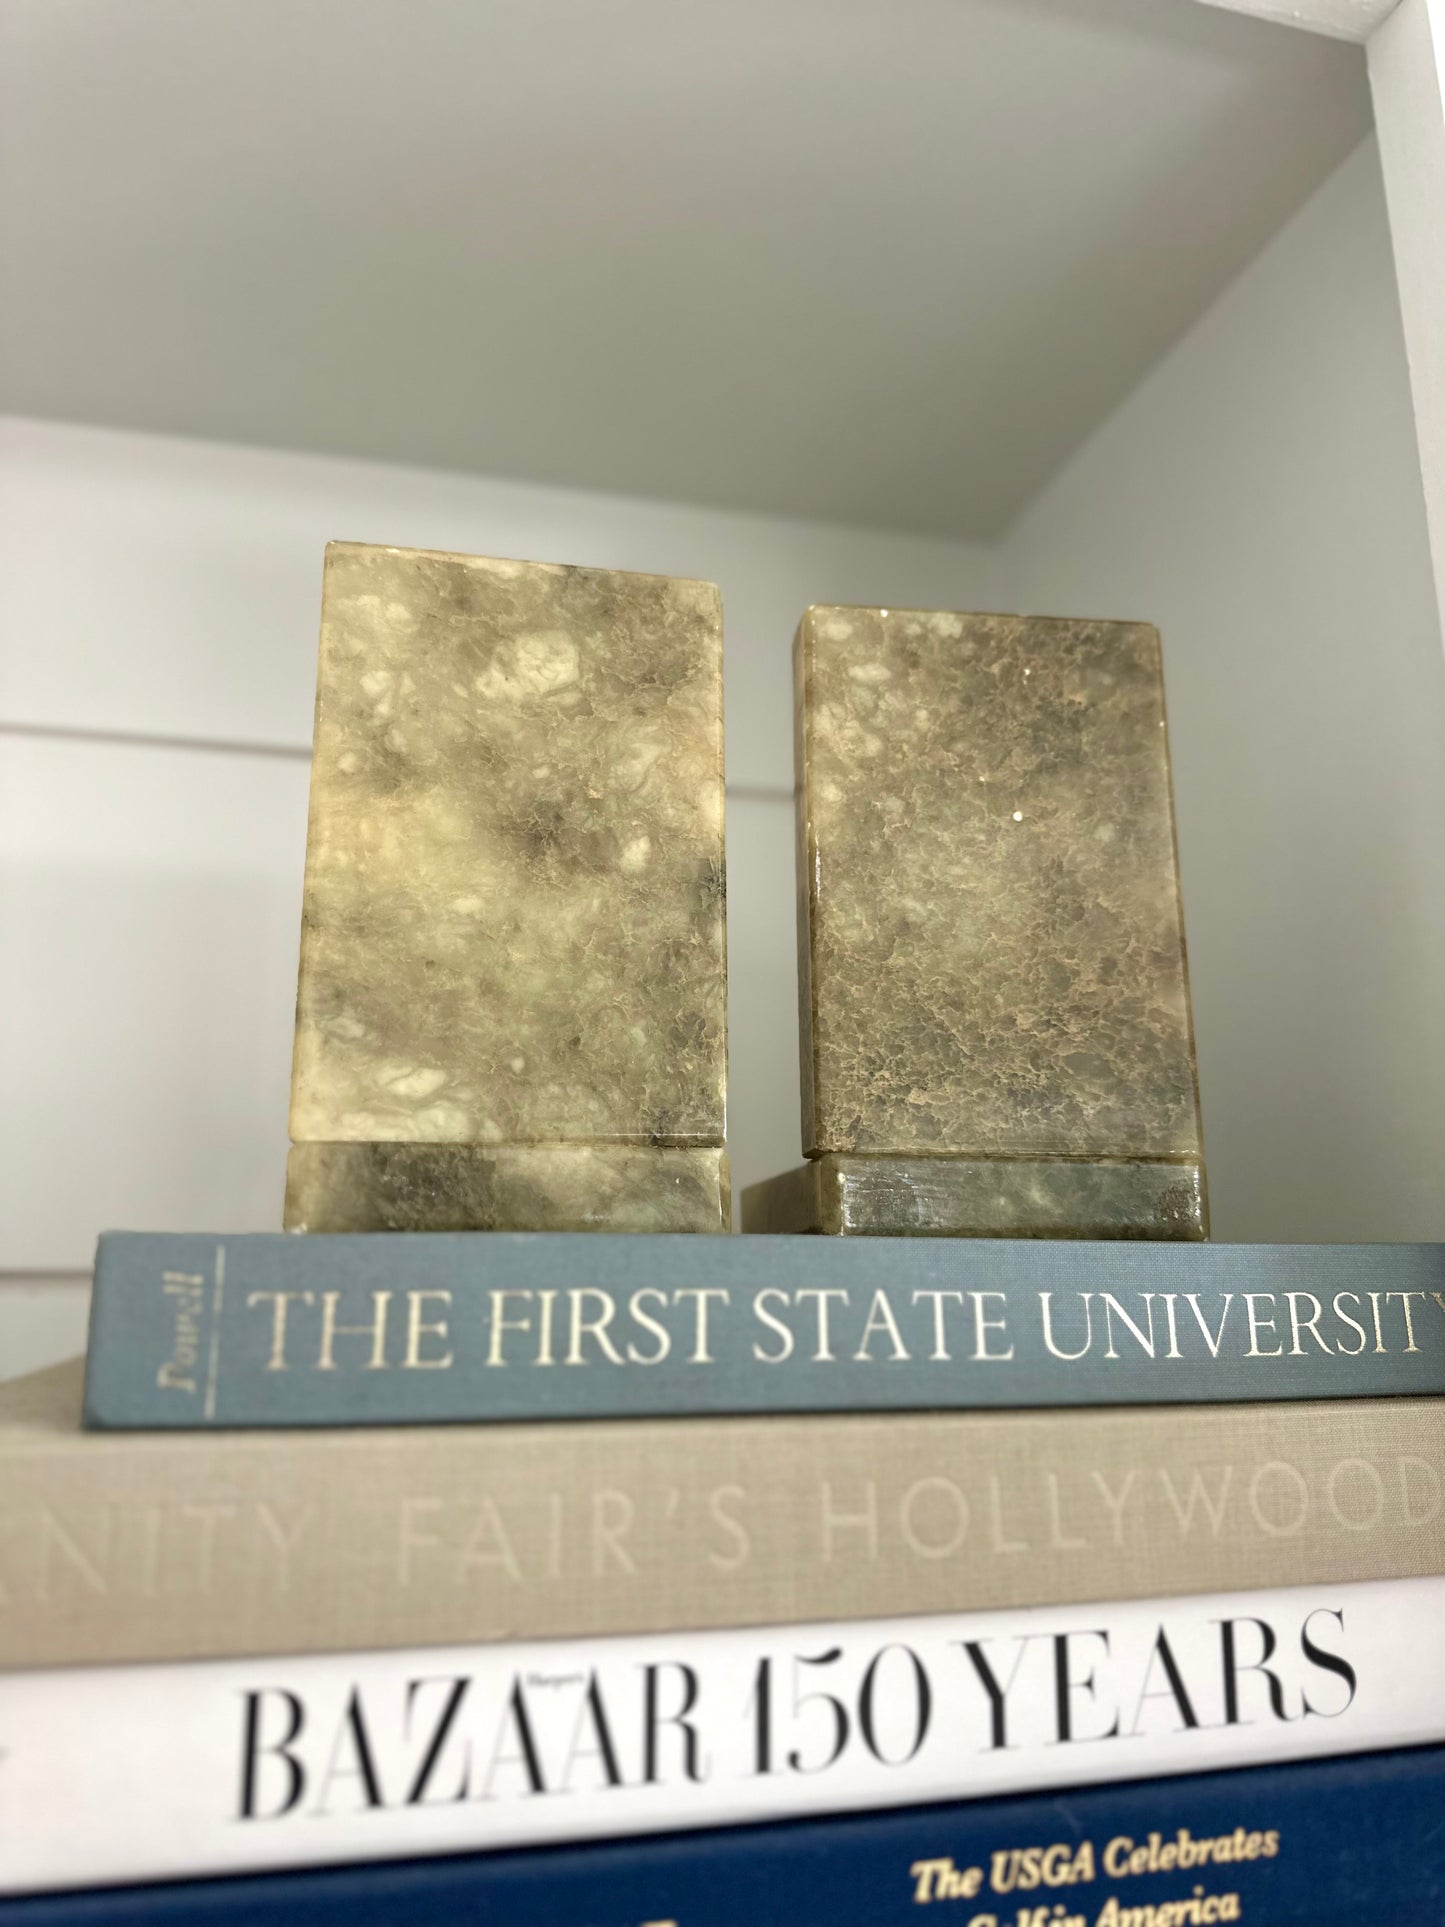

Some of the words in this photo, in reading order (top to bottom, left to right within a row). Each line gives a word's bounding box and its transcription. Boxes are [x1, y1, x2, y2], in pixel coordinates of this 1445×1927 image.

[246, 1290, 455, 1371] THE
[484, 1288, 732, 1368] FIRST
[751, 1287, 1015, 1363] STATE
[0, 1499, 318, 1608] NITY
[396, 1481, 752, 1587] FAIR'S
[820, 1455, 1442, 1562] HOLLYWOOD
[233, 1660, 714, 1824] BAZAAR
[740, 1642, 935, 1777] 150
[948, 1607, 1358, 1755] YEARS
[910, 1857, 984, 1904] The
[989, 1840, 1096, 1894] USGA
[1102, 1826, 1280, 1879] Celebrates
[1094, 1884, 1242, 1927] America
